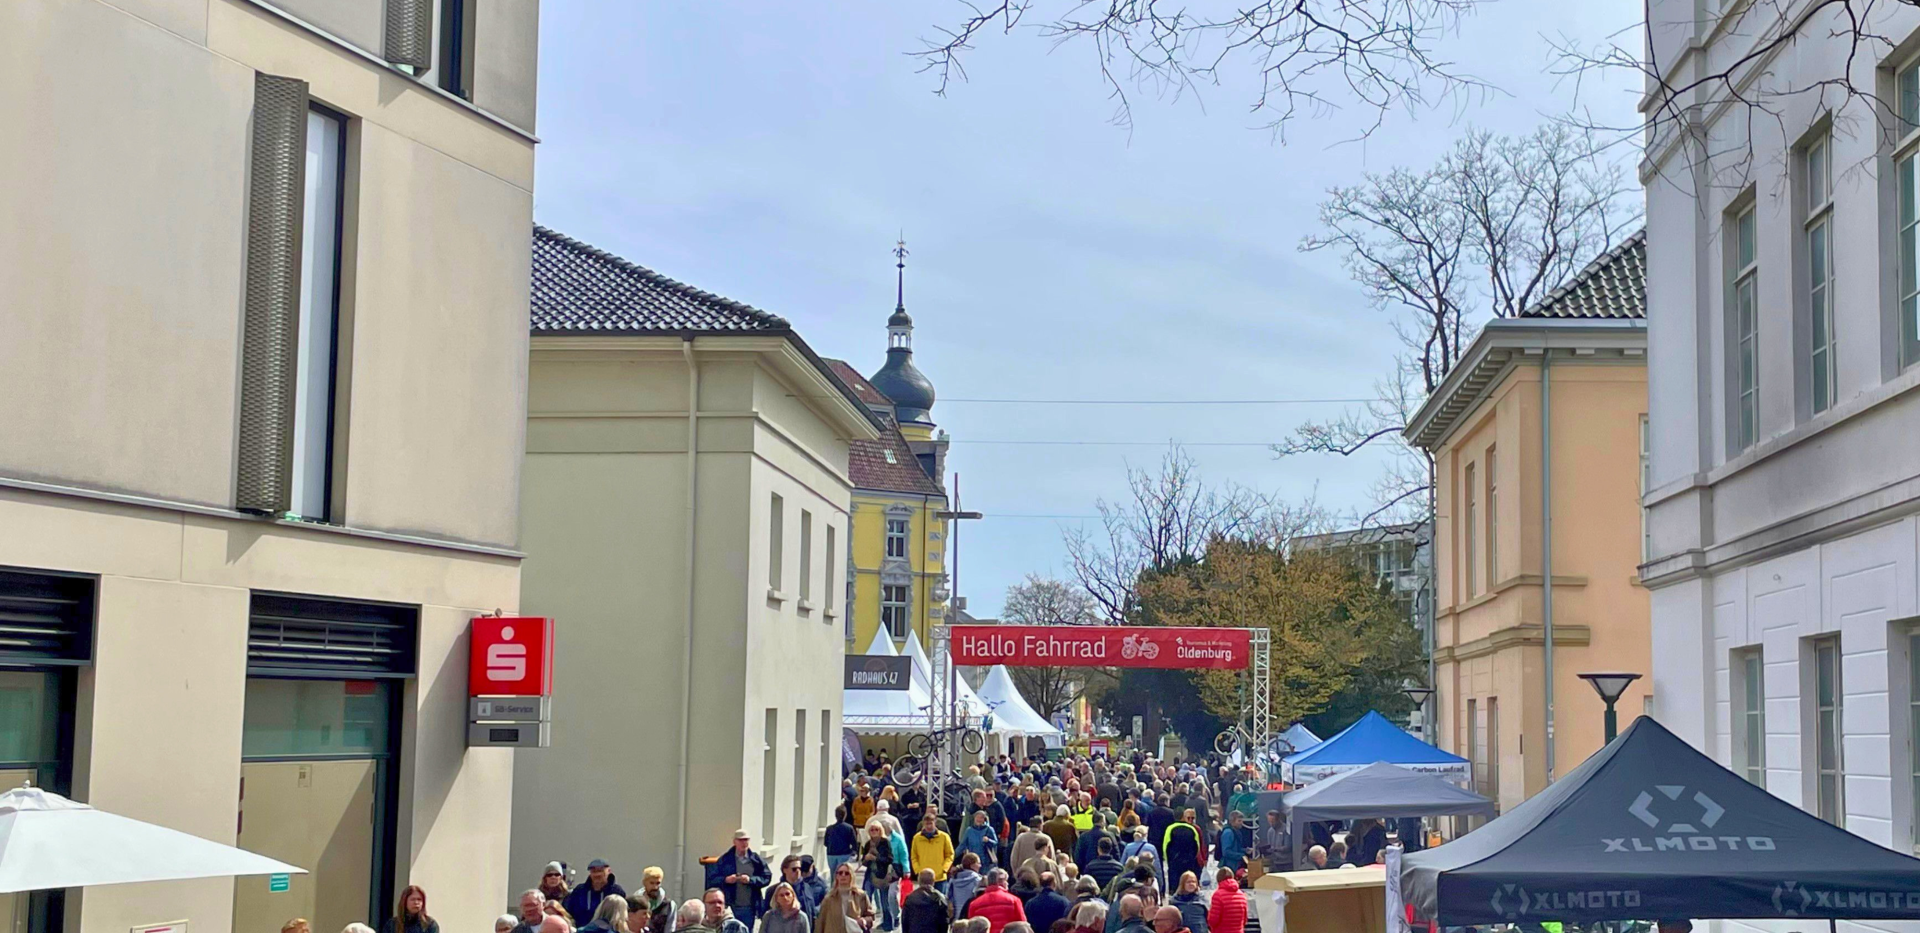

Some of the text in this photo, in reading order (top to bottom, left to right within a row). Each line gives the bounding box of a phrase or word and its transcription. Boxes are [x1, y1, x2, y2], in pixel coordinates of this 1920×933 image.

[962, 634, 1106, 658] Hallo Fahrrad
[852, 671, 898, 685] RADHAUS 47
[1601, 836, 1776, 852] XLMOTO
[1534, 890, 1641, 910] XLMOTO
[1815, 891, 1920, 909] XLMOTO
